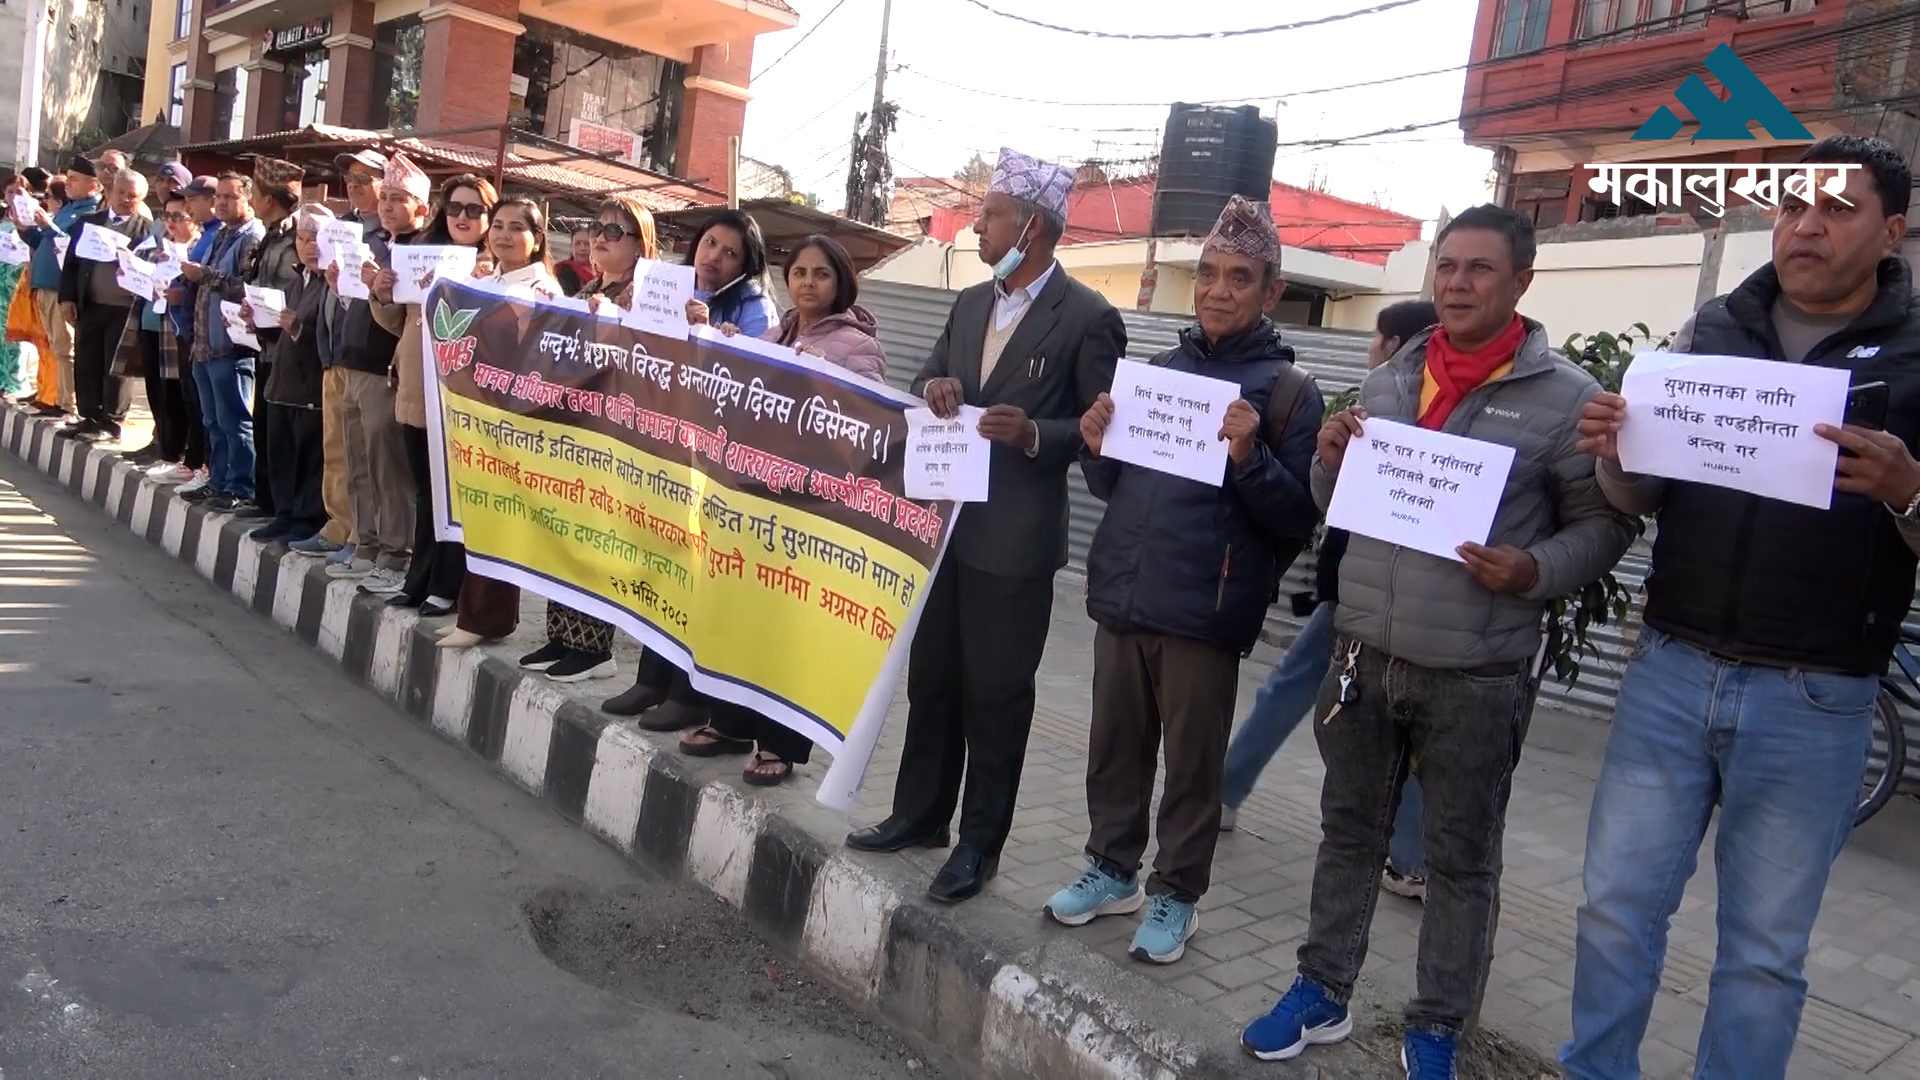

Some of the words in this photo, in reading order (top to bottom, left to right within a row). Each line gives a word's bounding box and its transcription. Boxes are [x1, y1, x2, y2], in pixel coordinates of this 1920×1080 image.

[632, 343, 674, 392] विरुद्ध
[744, 377, 796, 423] दिवस
[1664, 377, 1748, 402] सुशासनका
[1756, 387, 1797, 409] लागि
[1653, 404, 1707, 426] आर्थिक
[1713, 414, 1799, 439] दण्डहीनता
[474, 362, 515, 394] मानव
[511, 371, 564, 410] अधिकार
[565, 387, 603, 417] तथा
[636, 407, 678, 444] समाज
[809, 470, 894, 524] आयोजित
[894, 497, 942, 548] प्रदर्शन
[1395, 445, 1415, 460] पात्र
[1418, 451, 1426, 461] र
[1687, 434, 1727, 455] अन्त्य
[1735, 444, 1759, 461] गर
[1377, 462, 1424, 484] इतिहासले
[474, 416, 482, 434] र
[481, 419, 545, 455] प्रवृत्तिलाई
[548, 434, 614, 474] इतिहासले
[616, 458, 644, 489] खारेज
[702, 494, 744, 533] दण्डित
[748, 514, 777, 552] गर्नु
[781, 525, 868, 580] सुशासनको
[872, 561, 900, 597] माग
[901, 574, 915, 607] हो
[1389, 487, 1435, 511] गरिसक्यो
[476, 447, 521, 485] नेतालाई
[524, 470, 587, 504] कारबाही
[624, 502, 646, 529] नयाँ
[648, 514, 689, 549] सरकार
[709, 547, 745, 579] पुरानै
[756, 565, 811, 601] मार्गमा
[819, 587, 868, 631] अग्रसर
[493, 493, 526, 519] लागि
[529, 507, 570, 537] आर्थिक
[574, 524, 638, 564] दण्डहीनता
